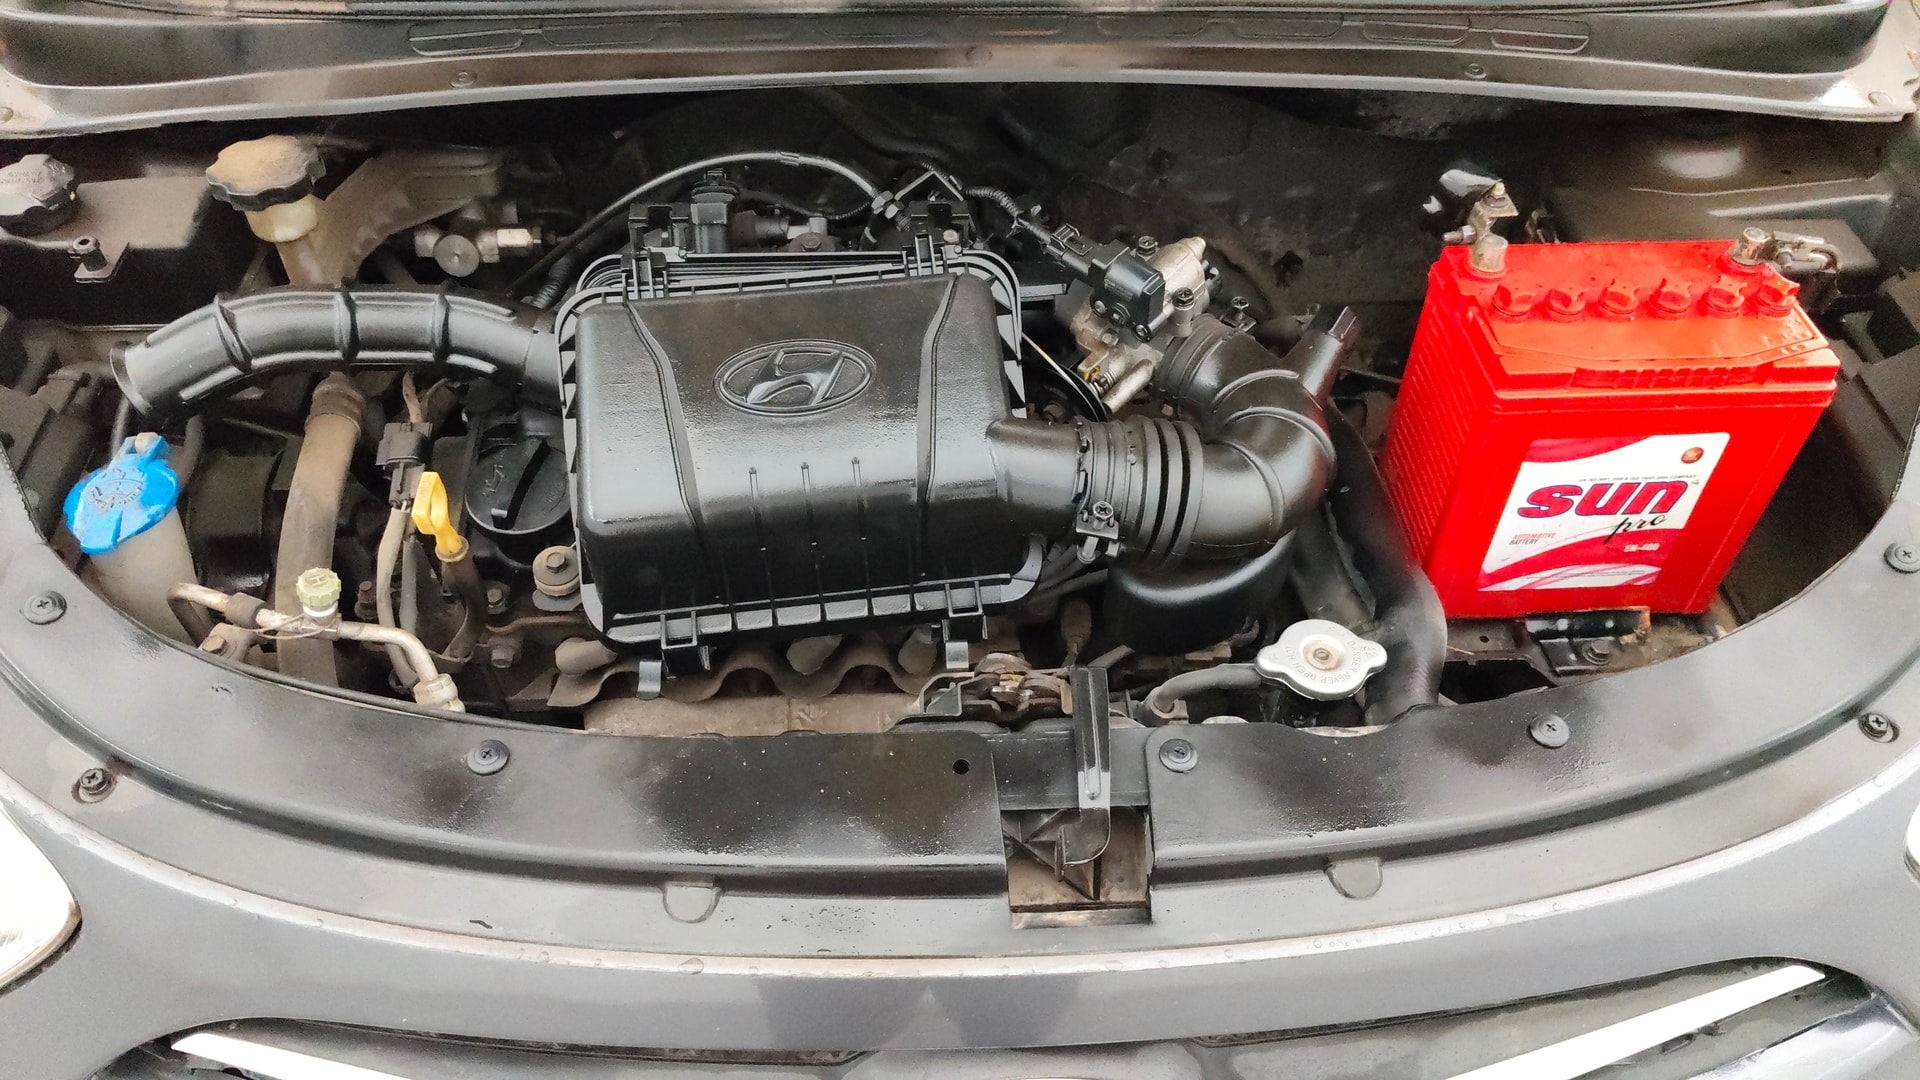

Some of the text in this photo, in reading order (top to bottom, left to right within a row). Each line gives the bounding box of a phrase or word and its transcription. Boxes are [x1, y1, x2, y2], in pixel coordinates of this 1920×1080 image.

[1517, 480, 1688, 518] sun
[1602, 514, 1667, 545] pro
[1293, 662, 1317, 681] OPEN
[1321, 672, 1352, 684] NEVER
